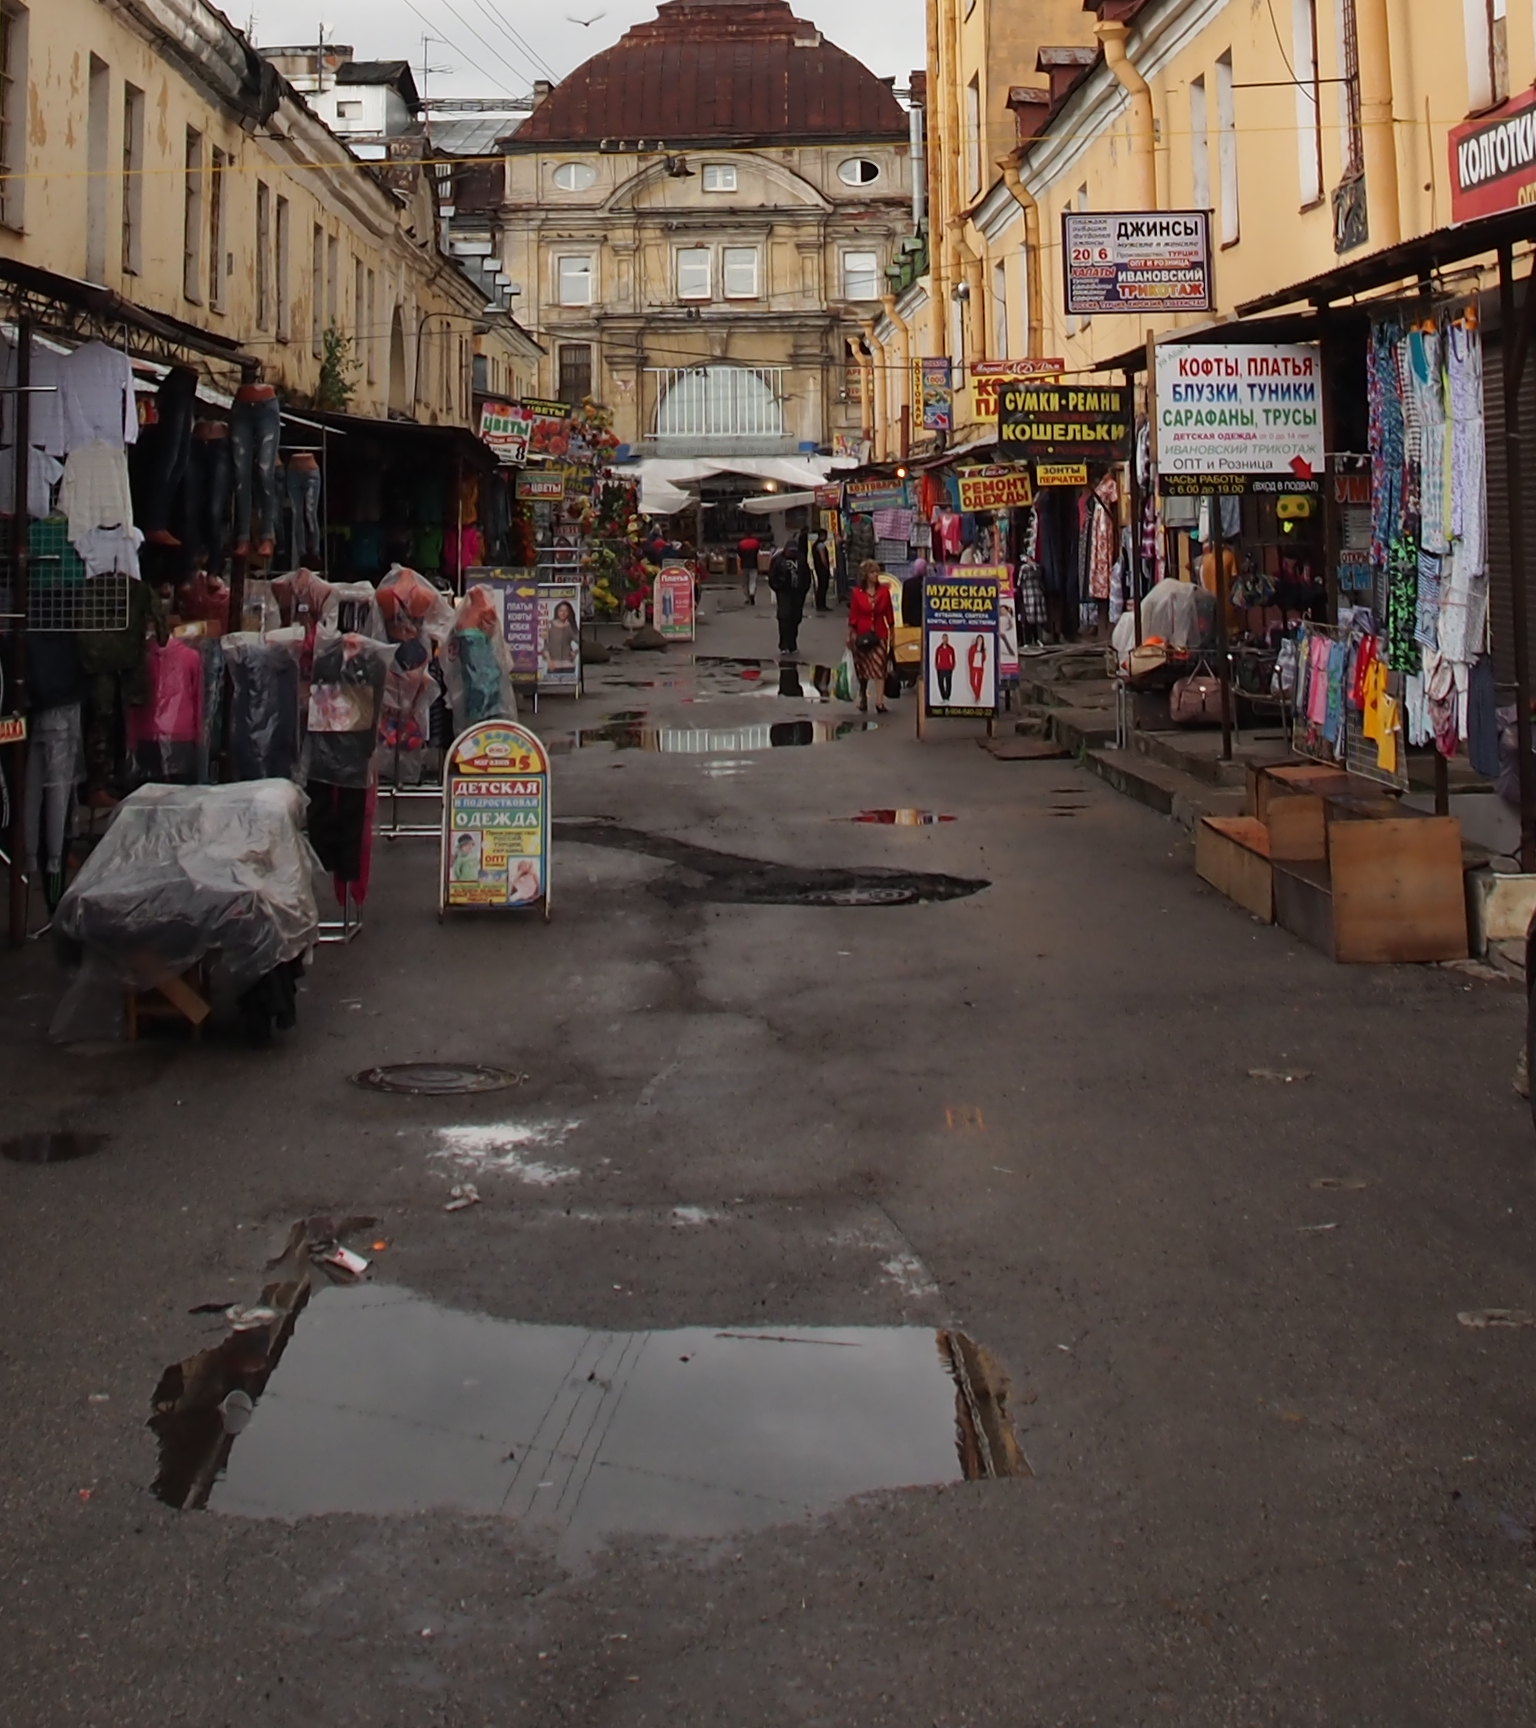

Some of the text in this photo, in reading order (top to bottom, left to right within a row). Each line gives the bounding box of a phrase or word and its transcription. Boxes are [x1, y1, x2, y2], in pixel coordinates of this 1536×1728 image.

[1117, 220, 1199, 241] ДЖИНСЫ
[1072, 248, 1091, 261] 20
[1097, 247, 1109, 261] 6
[1168, 250, 1199, 258] ТУРЦИЯ
[1071, 266, 1116, 278] ХАЛАТЫ
[1117, 267, 1204, 282] ИВАНОВСКИЙ
[1117, 283, 1205, 299] ТРИКОТАЖ
[1167, 345, 1188, 361] Allah
[1179, 357, 1314, 379] КОФТЫ, ПЛАТЬЯ
[913, 360, 923, 428] ХОЗТОВАРЫ
[1172, 382, 1315, 405] БЛУЗКИ, ТУНИКИ
[1005, 392, 1060, 412] СУМКИ
[1068, 392, 1121, 412] РЕМНИ
[527, 405, 566, 418] ЦВЕТЫ
[1162, 408, 1317, 429] САРАФАНЫ, ТРУСЫ
[483, 415, 530, 437] ЦВЕТЫ
[1001, 423, 1126, 441] КОШЕЛЬКИ
[1173, 433, 1215, 441] ДЕТСКАЯ
[1217, 432, 1257, 441] ОДЕЖДА
[515, 445, 527, 461] 8
[1165, 443, 1318, 456] ИВАНОВСКИЙ ТРИКОТАЖ
[1042, 466, 1081, 475] ЗОНТЫ
[1173, 457, 1273, 471] ОПТ и Розница
[848, 479, 902, 494] ХОЗТОВАРЫ
[961, 476, 1028, 496] РЕМОНТ
[1039, 475, 1086, 484] ПЕРЧАТКИ
[1165, 474, 1197, 485] ЧАСЫ
[531, 483, 562, 494] ЦВЕТЫ
[1177, 484, 1200, 495] 6.00
[1201, 485, 1215, 495] до
[1217, 484, 1244, 494] 19.00
[962, 490, 1029, 509] ОДЕЖДЫ
[926, 584, 997, 598] МУЖСКАЯ
[929, 597, 994, 612] ОДЕЖДА
[507, 612, 533, 621] КОФТЫ
[507, 632, 532, 641] БРЮКИ
[511, 642, 535, 652] ОСИНЫ
[518, 754, 531, 771] 5
[455, 781, 539, 796] ДЕТСКАЯ
[463, 798, 539, 808] ПОДРОСТКОВАЯ
[455, 812, 539, 827] ОДЕЖДА
[484, 855, 506, 863] ОПТ
